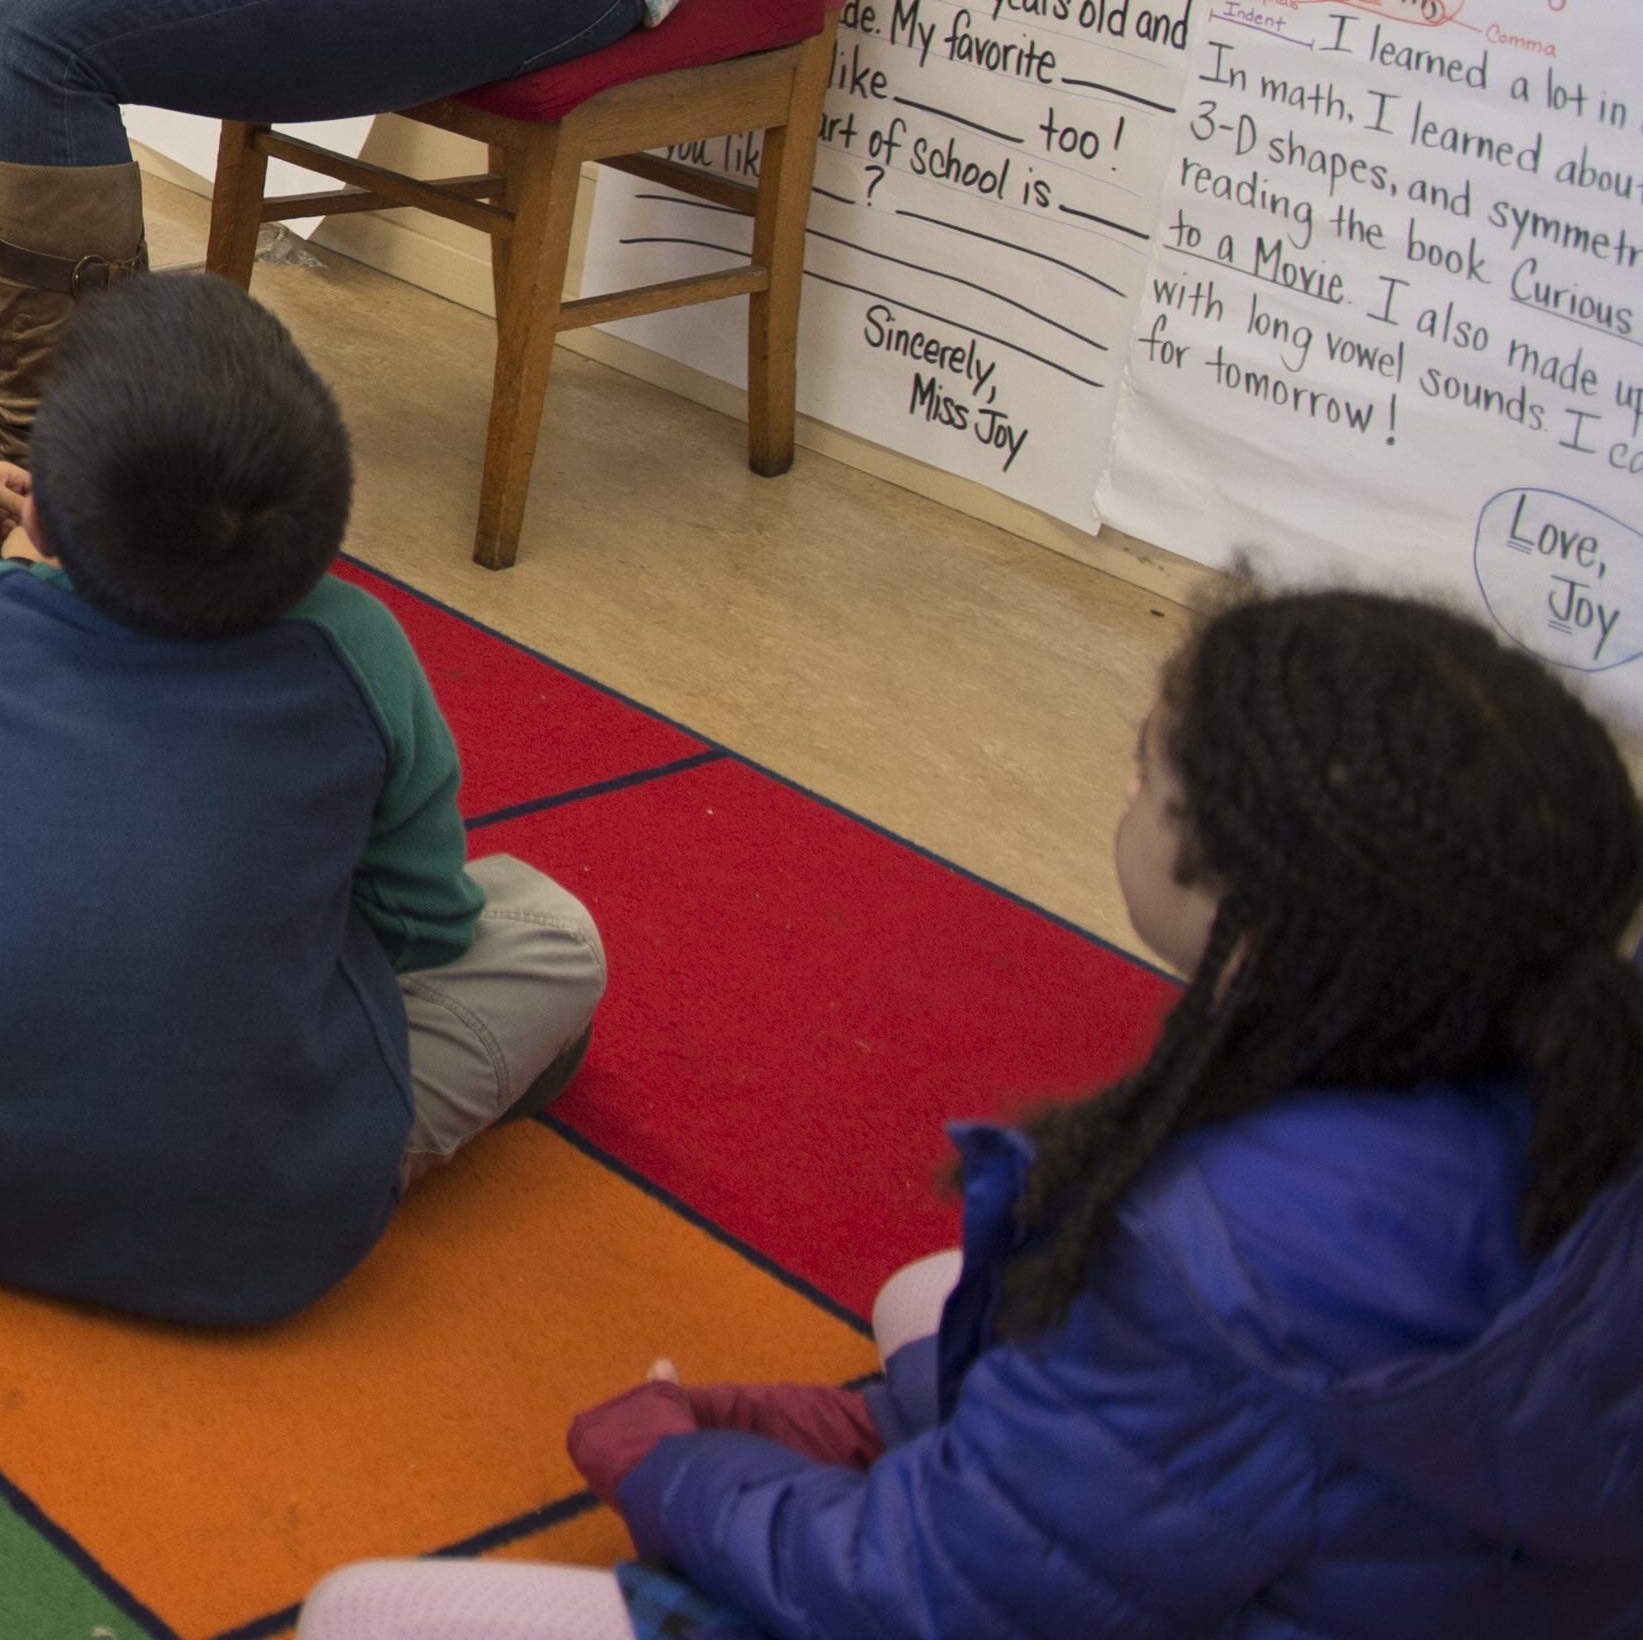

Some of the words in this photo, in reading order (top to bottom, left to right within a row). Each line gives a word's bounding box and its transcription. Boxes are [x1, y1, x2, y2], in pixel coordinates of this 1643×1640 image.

[1223, 2, 1288, 31] Indent
[1485, 24, 1558, 58] Comma
[862, 307, 996, 403] Sincerely,
[1139, 327, 1192, 368] for
[909, 374, 969, 430] Miss
[975, 410, 1028, 471] Joy
[1509, 495, 1607, 577] Love,
[1547, 575, 1621, 662] Joy
